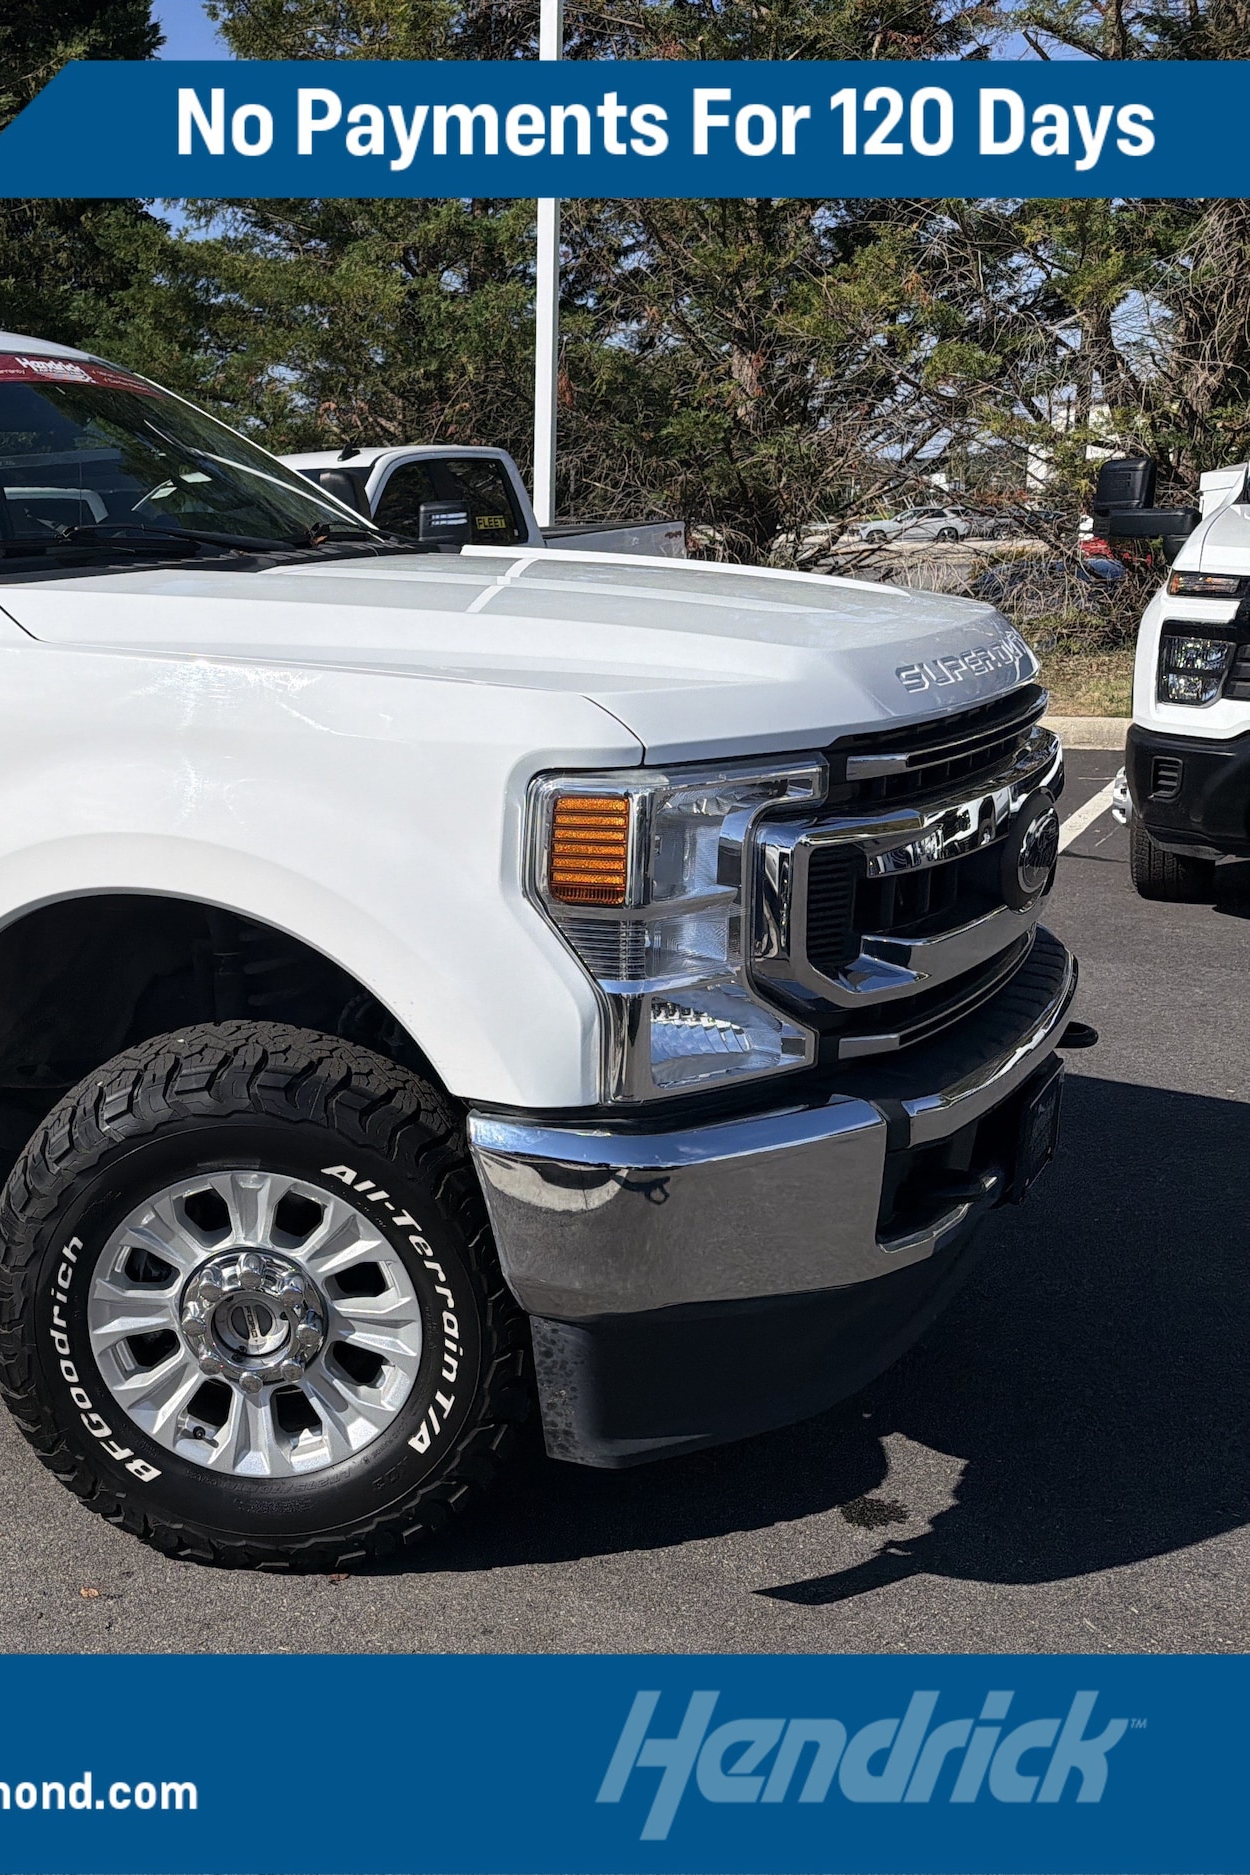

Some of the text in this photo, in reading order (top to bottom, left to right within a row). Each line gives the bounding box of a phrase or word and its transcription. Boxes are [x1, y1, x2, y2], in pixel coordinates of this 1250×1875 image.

[477, 516, 506, 530] FLEET
[50, 1236, 162, 1483] BFGoodrich
[321, 1164, 464, 1383] All-Terrain
[407, 1390, 456, 1455] T/A
